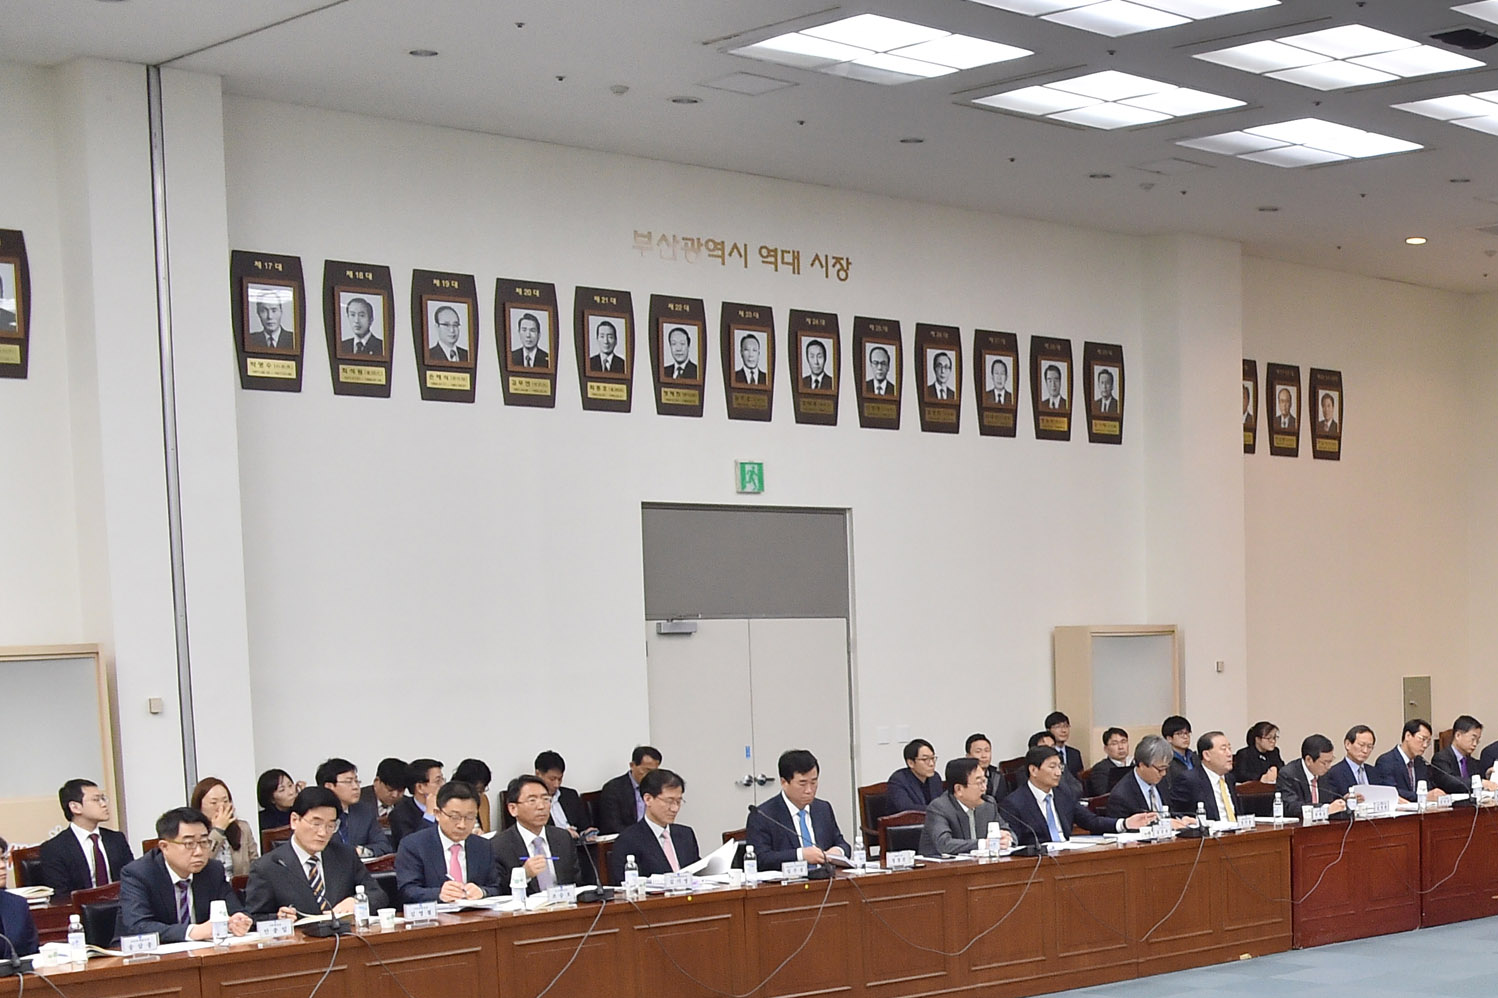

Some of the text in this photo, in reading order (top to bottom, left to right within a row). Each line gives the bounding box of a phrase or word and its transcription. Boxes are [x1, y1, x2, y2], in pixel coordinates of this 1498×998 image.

[633, 230, 852, 282] 부산광역시 역대 시장
